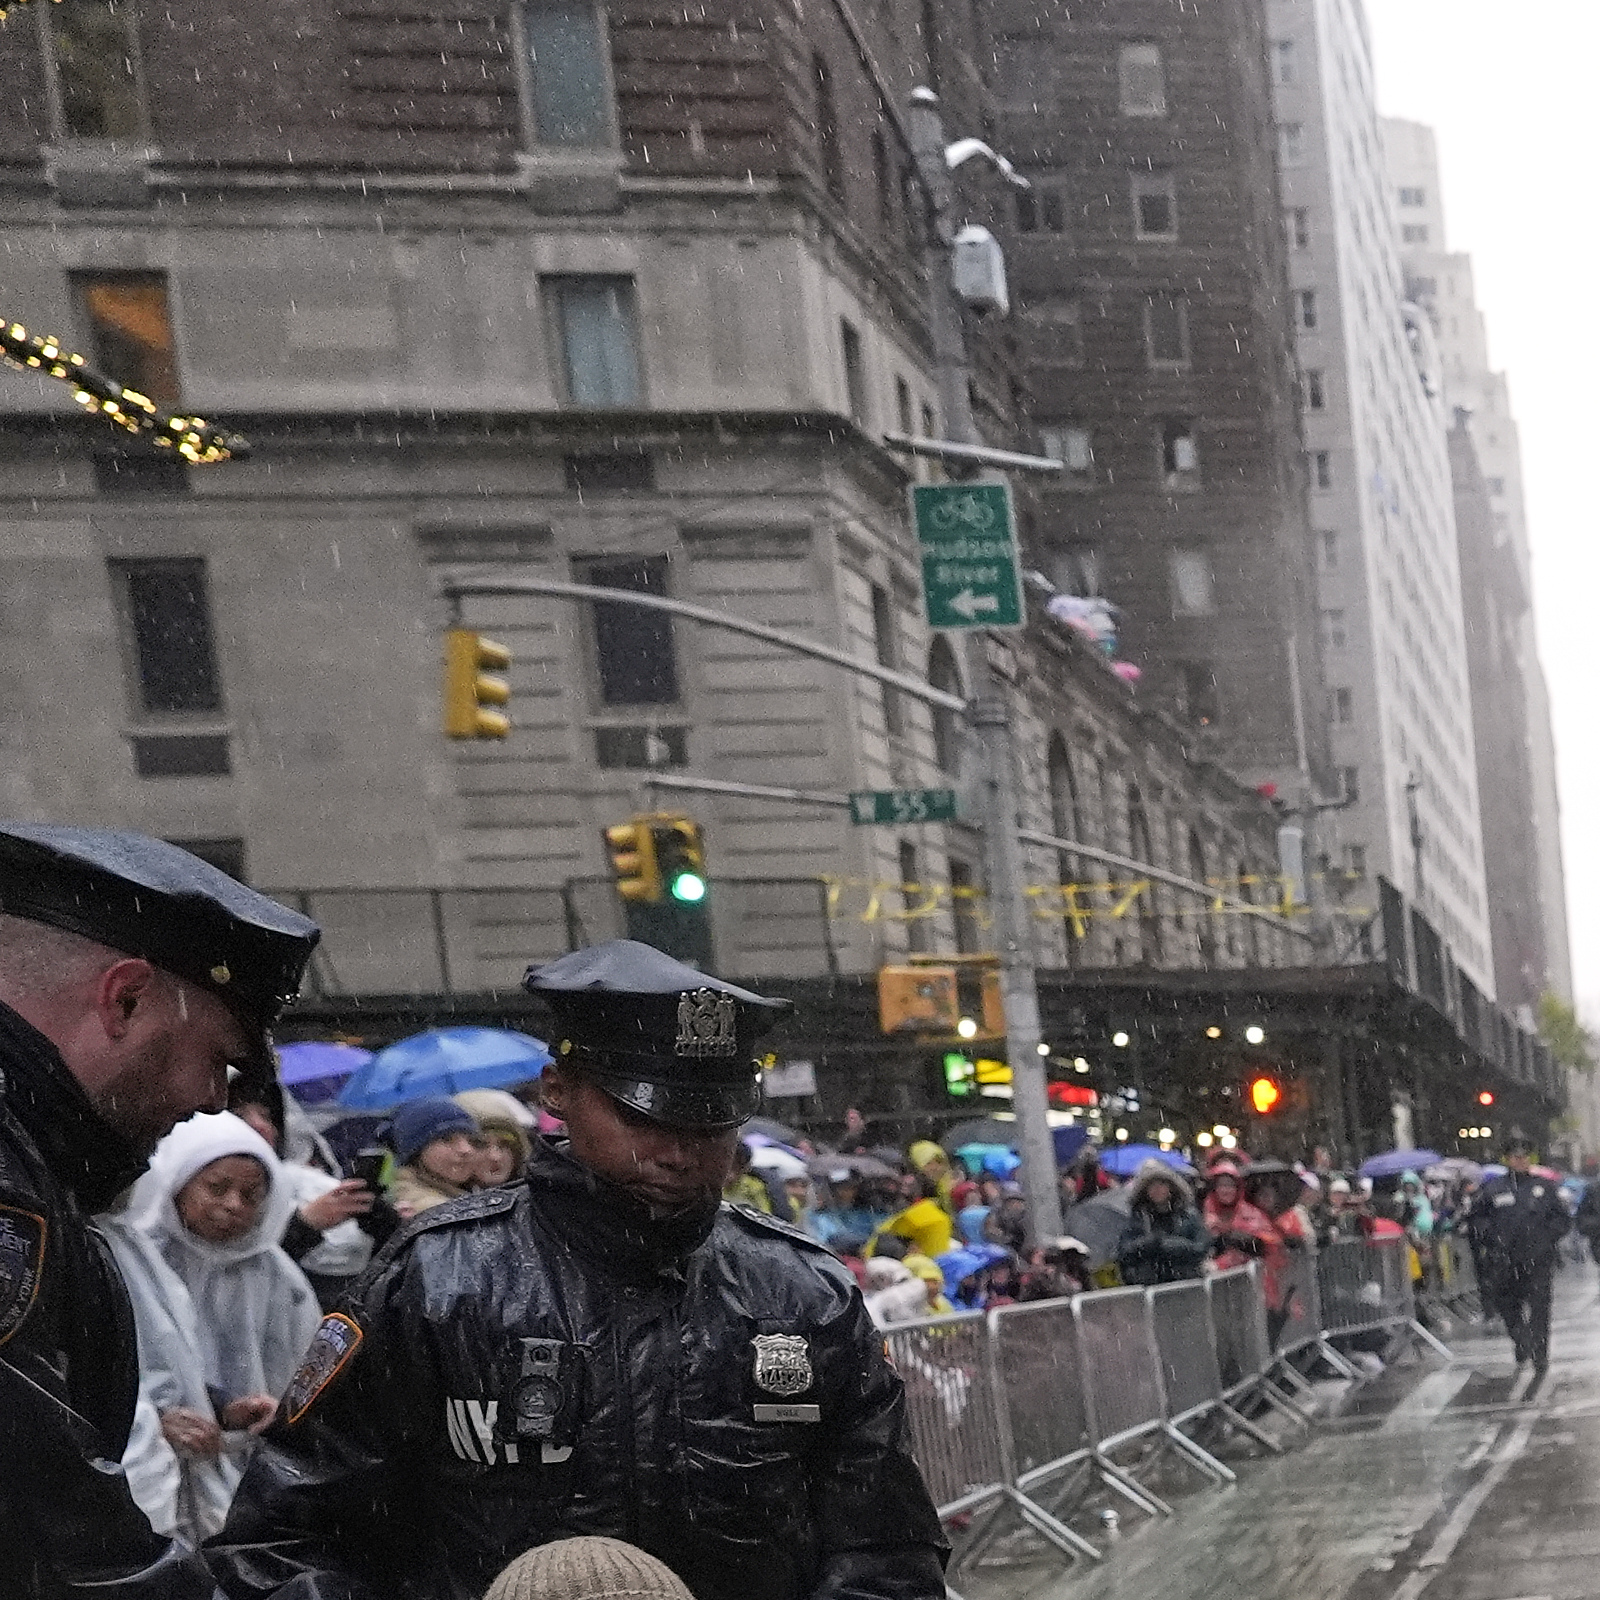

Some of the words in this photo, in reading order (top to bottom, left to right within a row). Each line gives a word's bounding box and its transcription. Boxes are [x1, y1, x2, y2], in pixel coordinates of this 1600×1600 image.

[921, 538, 1015, 559] Hudson
[935, 563, 999, 584] River
[892, 790, 928, 820] 55
